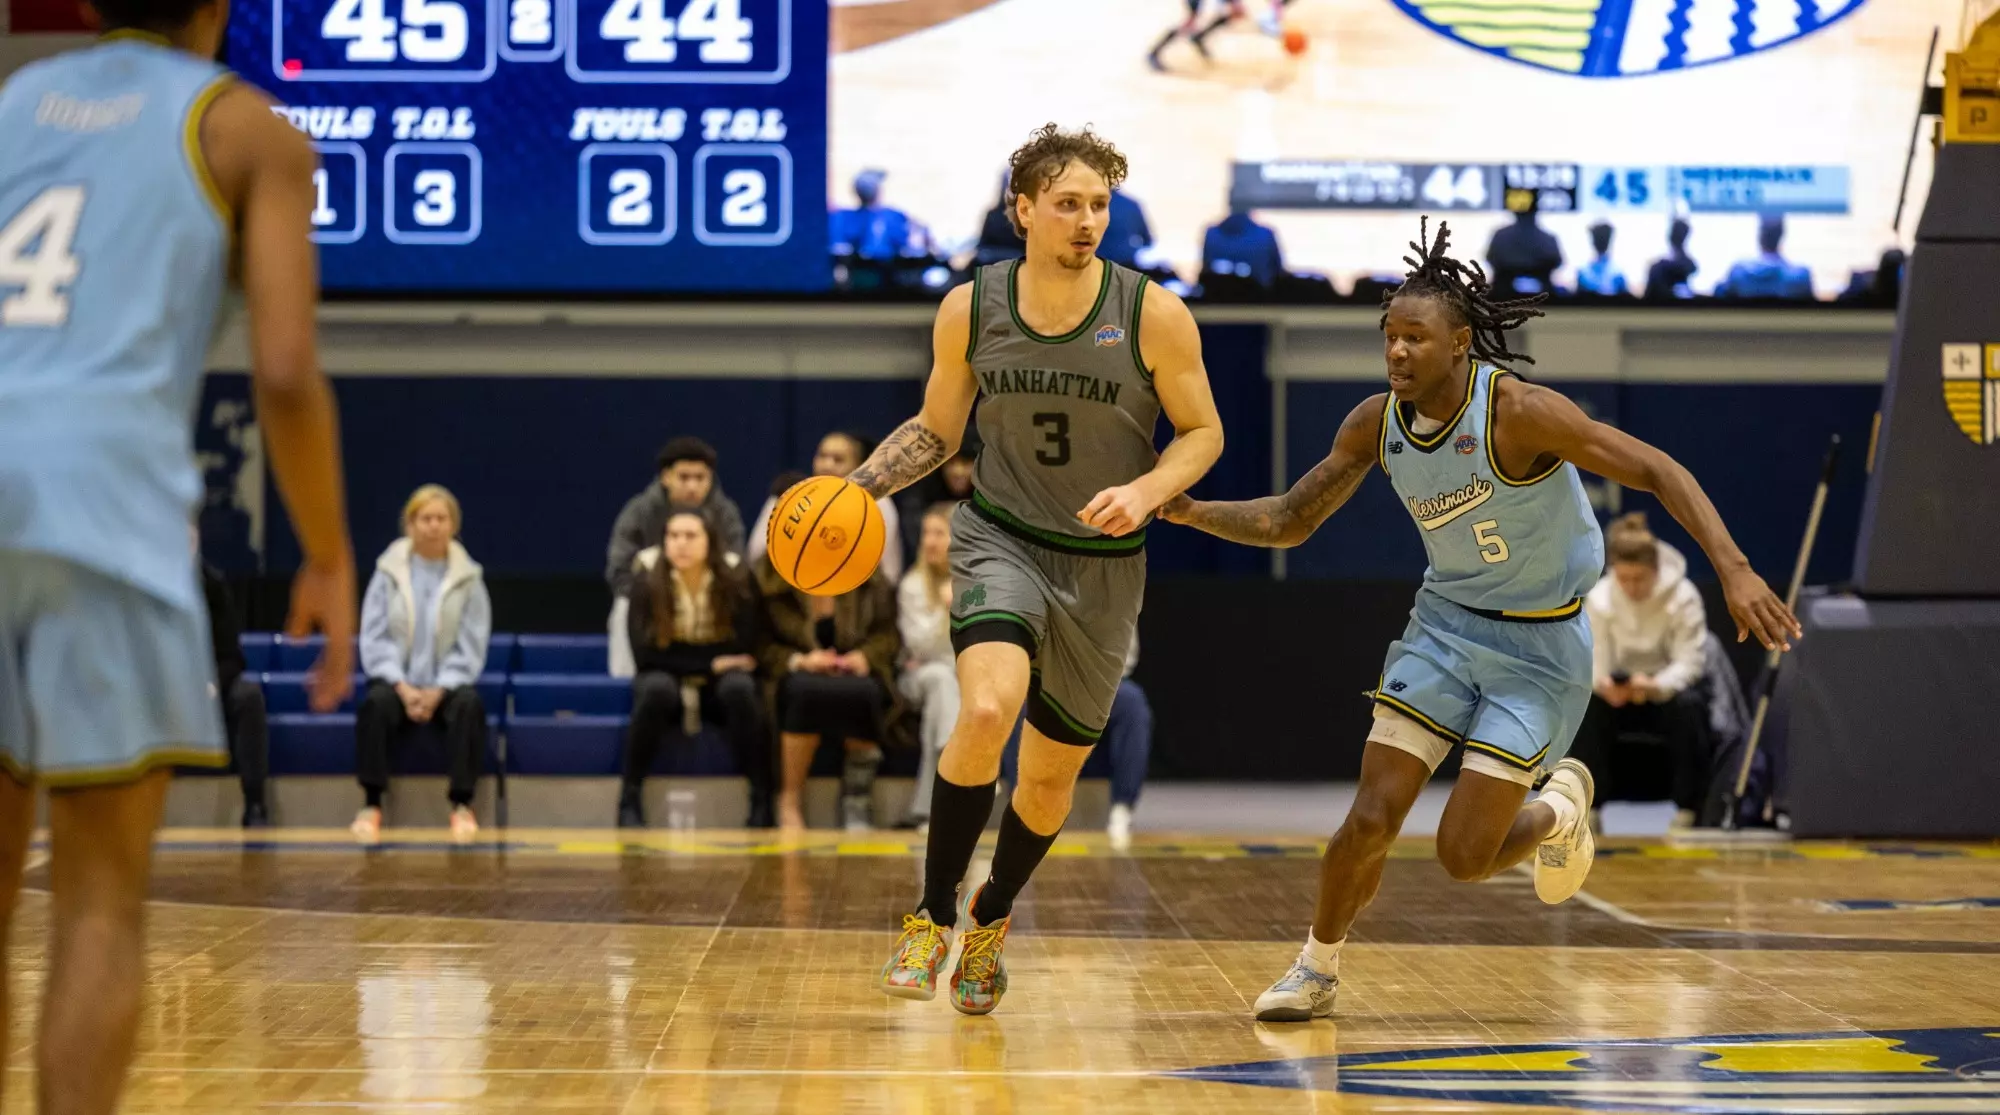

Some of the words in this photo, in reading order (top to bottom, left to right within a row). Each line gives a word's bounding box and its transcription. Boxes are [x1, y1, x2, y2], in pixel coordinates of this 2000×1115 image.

[321, 0, 469, 62] 45
[510, 0, 551, 43] 2
[600, 0, 753, 63] 44
[270, 106, 377, 140] OULS
[569, 107, 688, 142] FOULS
[310, 169, 338, 226] 1
[413, 169, 457, 227] 3
[607, 168, 653, 226] 2
[722, 168, 768, 227] 2
[1422, 165, 1487, 207] 44
[1595, 170, 1650, 204] 45
[0, 184, 86, 328] 4
[981, 368, 1122, 405] MANHATTAN
[1033, 412, 1071, 466] 3
[1407, 473, 1494, 519] Merrimack
[1471, 518, 1510, 564] 5
